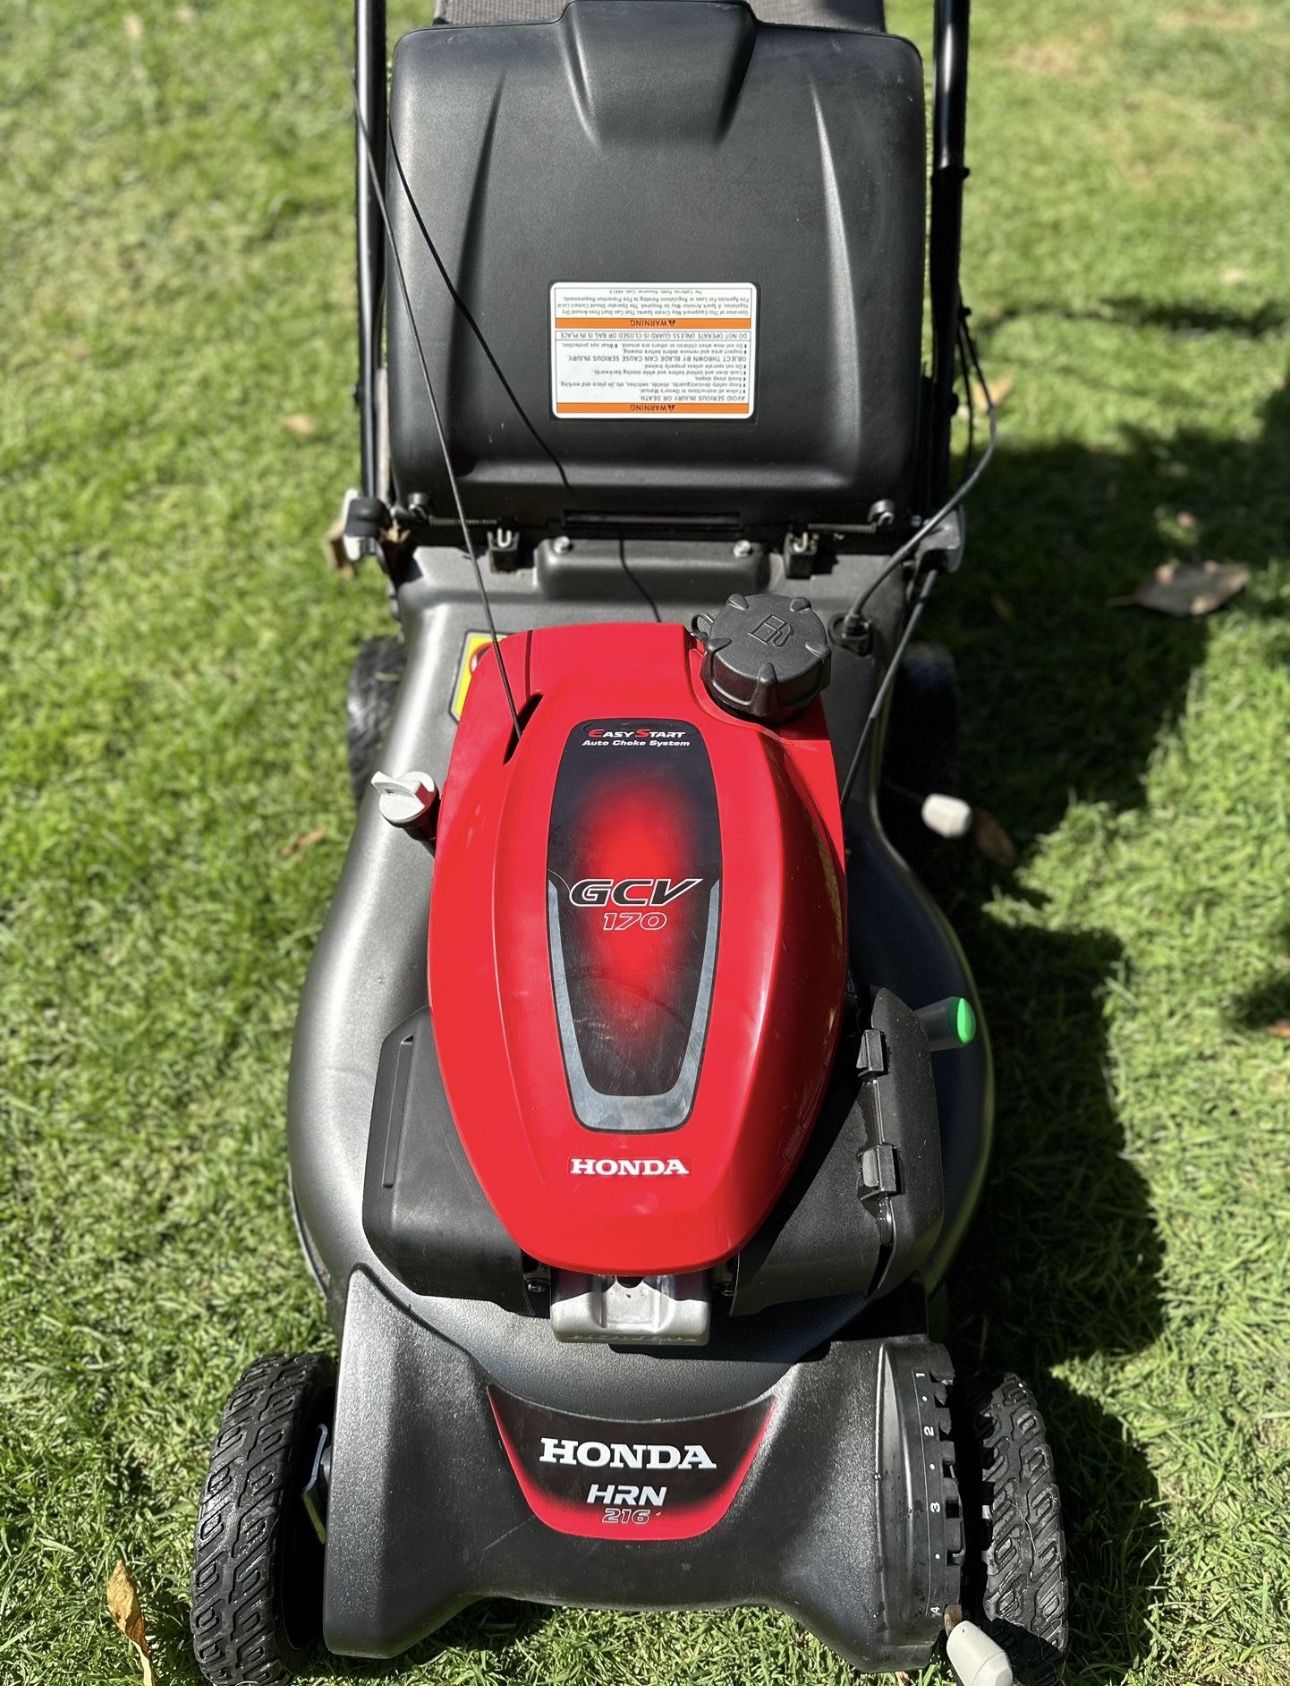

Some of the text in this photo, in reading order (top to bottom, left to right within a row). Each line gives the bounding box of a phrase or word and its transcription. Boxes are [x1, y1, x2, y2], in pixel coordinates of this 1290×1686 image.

[582, 739, 690, 748] Auto Choke System
[569, 878, 703, 907] GCV
[603, 912, 668, 931] 170
[570, 1158, 689, 1176] HONDA
[923, 1425, 936, 1437] 2
[539, 1437, 717, 1471] HONDA
[586, 1484, 668, 1507] HRN
[601, 1507, 652, 1525] 216
[929, 1502, 941, 1514] 3
